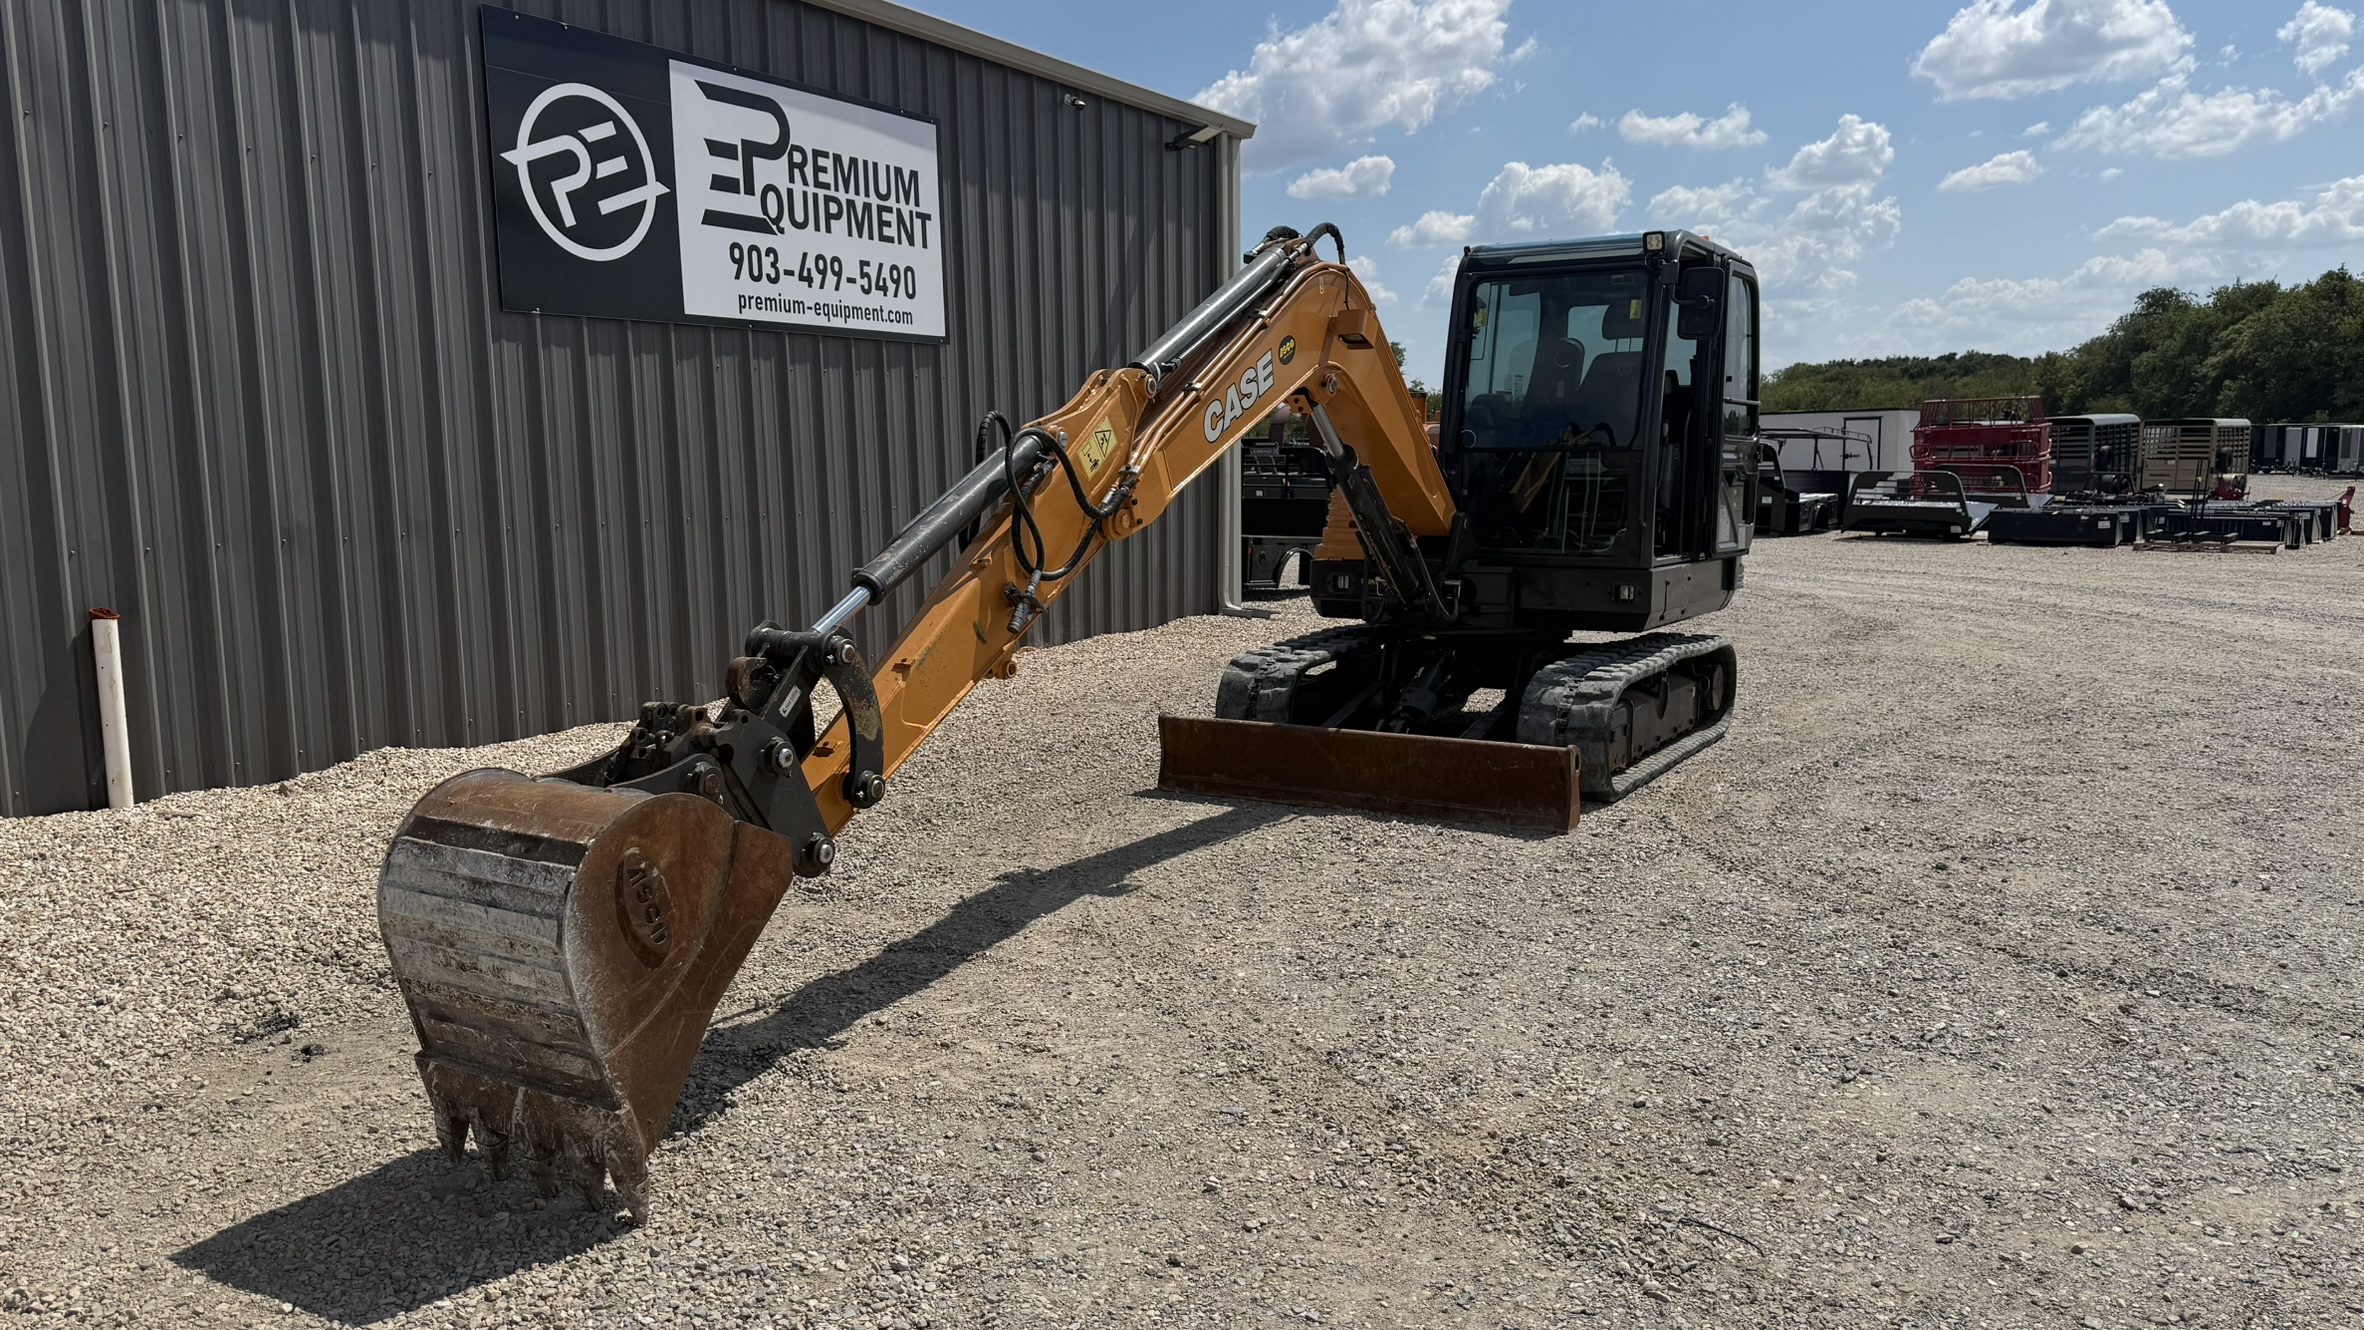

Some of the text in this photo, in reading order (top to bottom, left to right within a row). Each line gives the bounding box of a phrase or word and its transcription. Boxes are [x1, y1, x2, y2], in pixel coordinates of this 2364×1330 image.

[694, 79, 920, 208] PREMIUM
[701, 137, 932, 249] EQUIPMENT
[729, 241, 917, 300] 903-499-5490
[738, 292, 913, 325] premium-equipment.com
[1203, 347, 1275, 443] CASE
